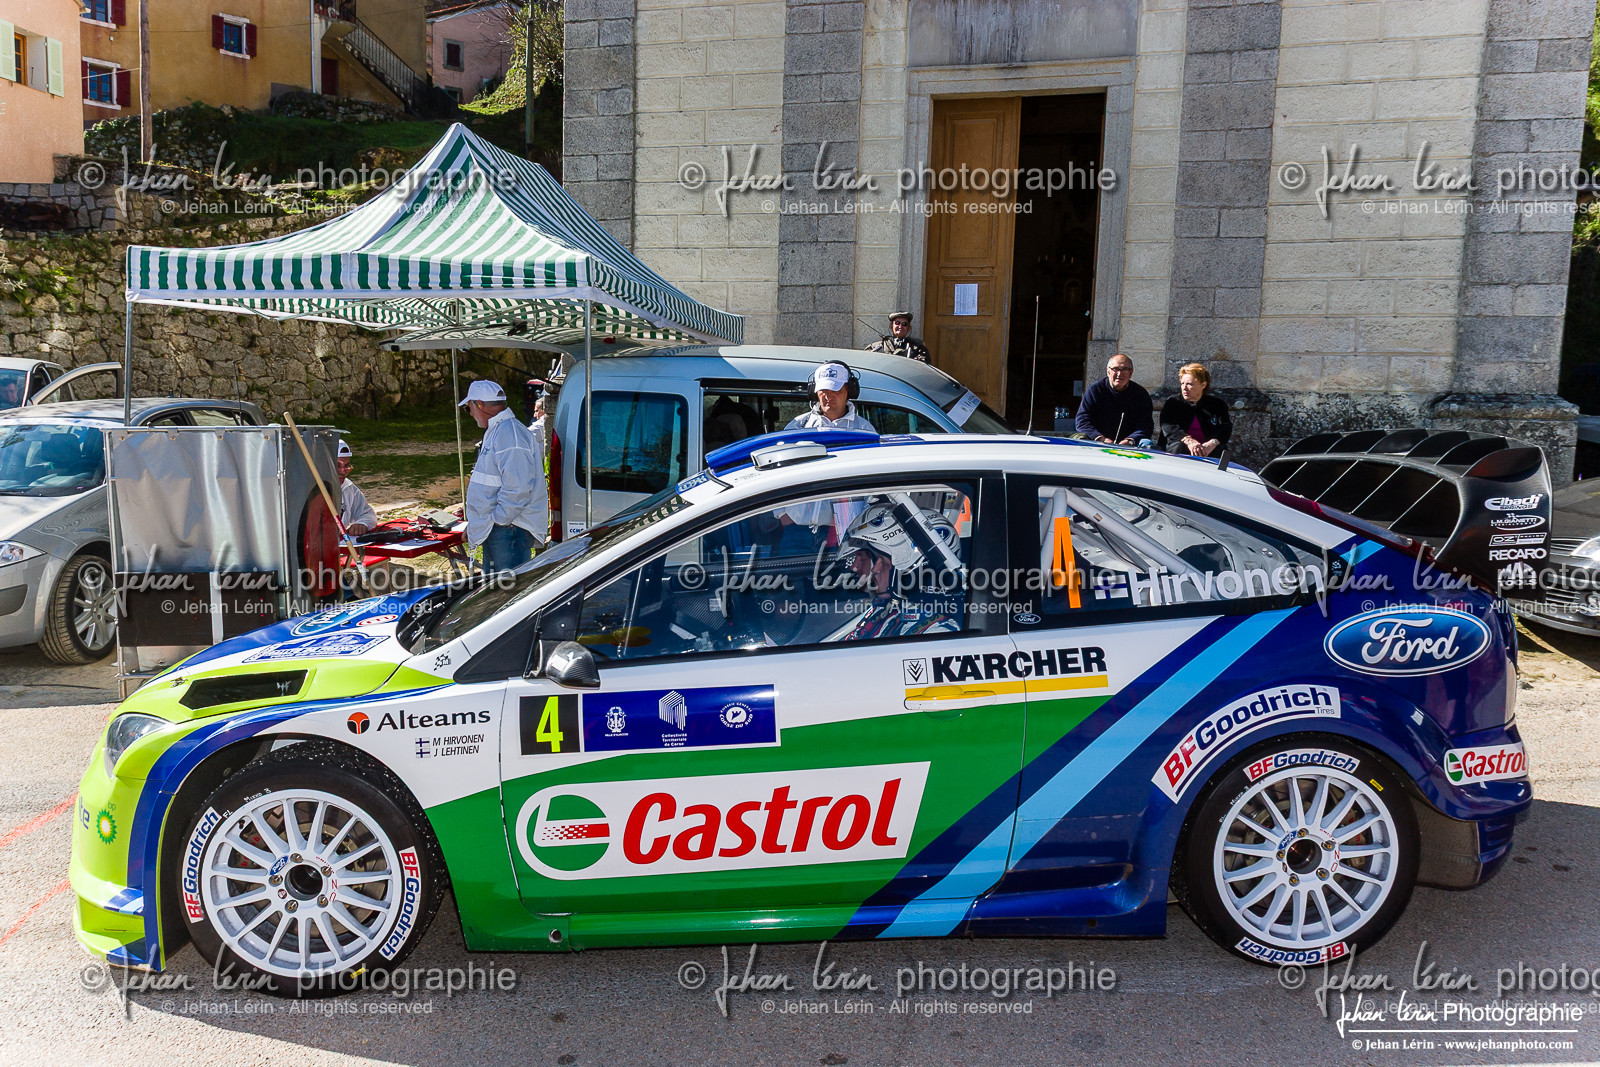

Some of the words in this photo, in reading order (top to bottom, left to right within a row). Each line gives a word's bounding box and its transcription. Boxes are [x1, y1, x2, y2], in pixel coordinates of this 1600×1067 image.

[1052, 517, 1082, 609] 4
[1489, 548, 1547, 561] RECARO
[1128, 562, 1323, 607] Hirvonen
[1361, 617, 1460, 664] Ford
[931, 646, 1107, 684] KÄRCHER
[377, 710, 491, 732] Alteams
[535, 696, 564, 754] 4
[1316, 707, 1335, 715] Tires
[432, 738, 441, 747] M
[443, 734, 485, 746] HIRVONEN
[433, 748, 439, 757] J
[441, 745, 480, 757] LEHTINEN
[1163, 687, 1332, 788] BFGoodrich
[1249, 751, 1357, 781] BFGoodrich
[1462, 745, 1527, 778] Castrol
[623, 778, 902, 865] Castrol
[184, 810, 220, 919] BFGoodrich
[381, 852, 420, 957] BFGoodrich
[1239, 938, 1345, 964] BFGoodrich
